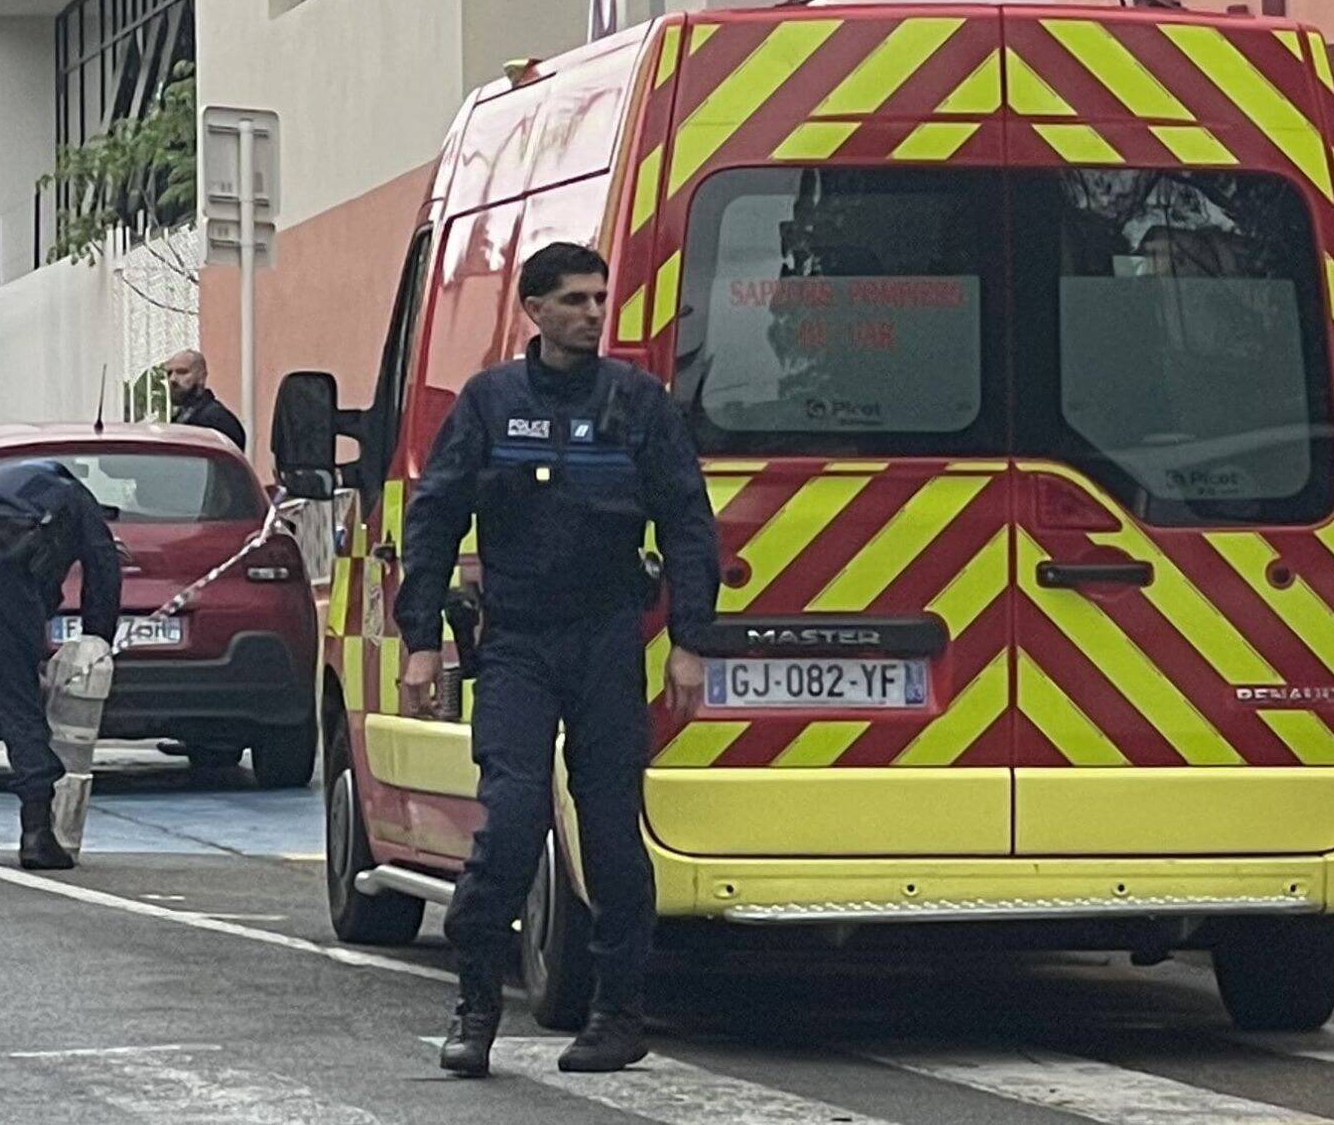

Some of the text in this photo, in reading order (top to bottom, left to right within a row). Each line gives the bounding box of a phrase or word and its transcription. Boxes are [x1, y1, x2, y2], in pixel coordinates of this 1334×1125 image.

[508, 419, 550, 433] POLICE
[747, 630, 880, 645] MASTER
[731, 663, 897, 698] GJ-082-YF
